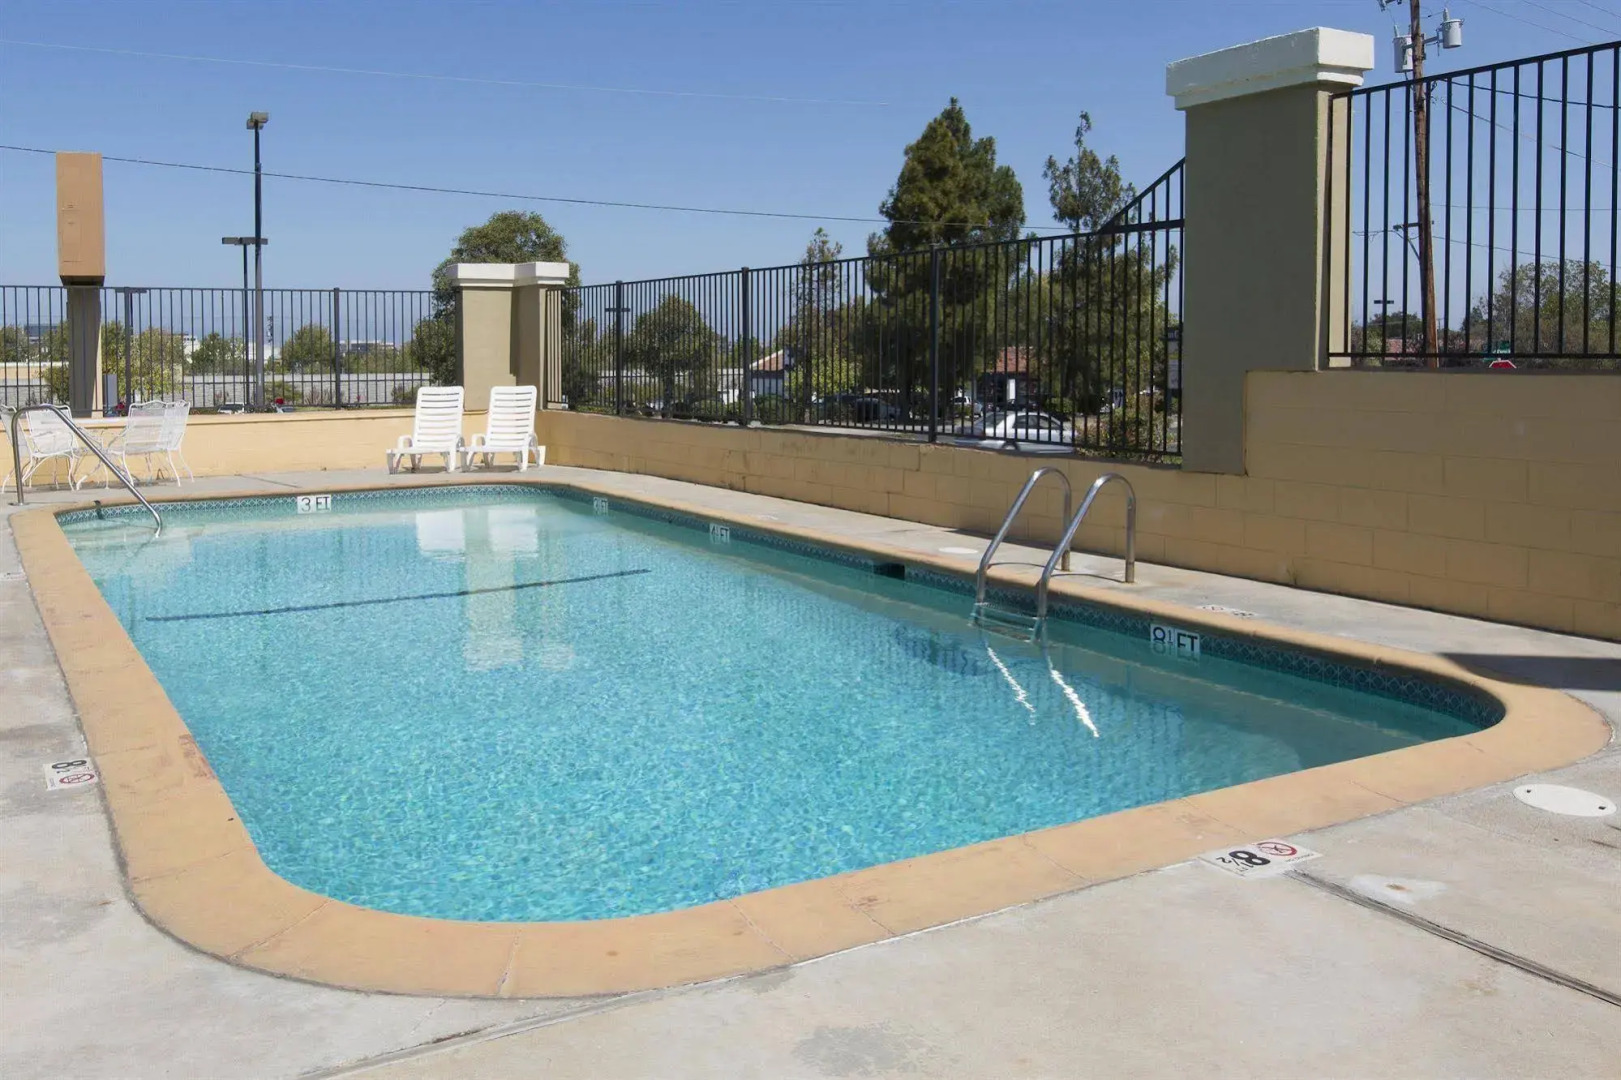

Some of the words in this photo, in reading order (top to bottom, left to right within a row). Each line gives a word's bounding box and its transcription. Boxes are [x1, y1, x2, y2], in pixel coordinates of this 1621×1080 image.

[301, 497, 311, 512] 3
[316, 497, 330, 510] FT
[1177, 633, 1198, 652] FT
[1229, 851, 1271, 866] 8
